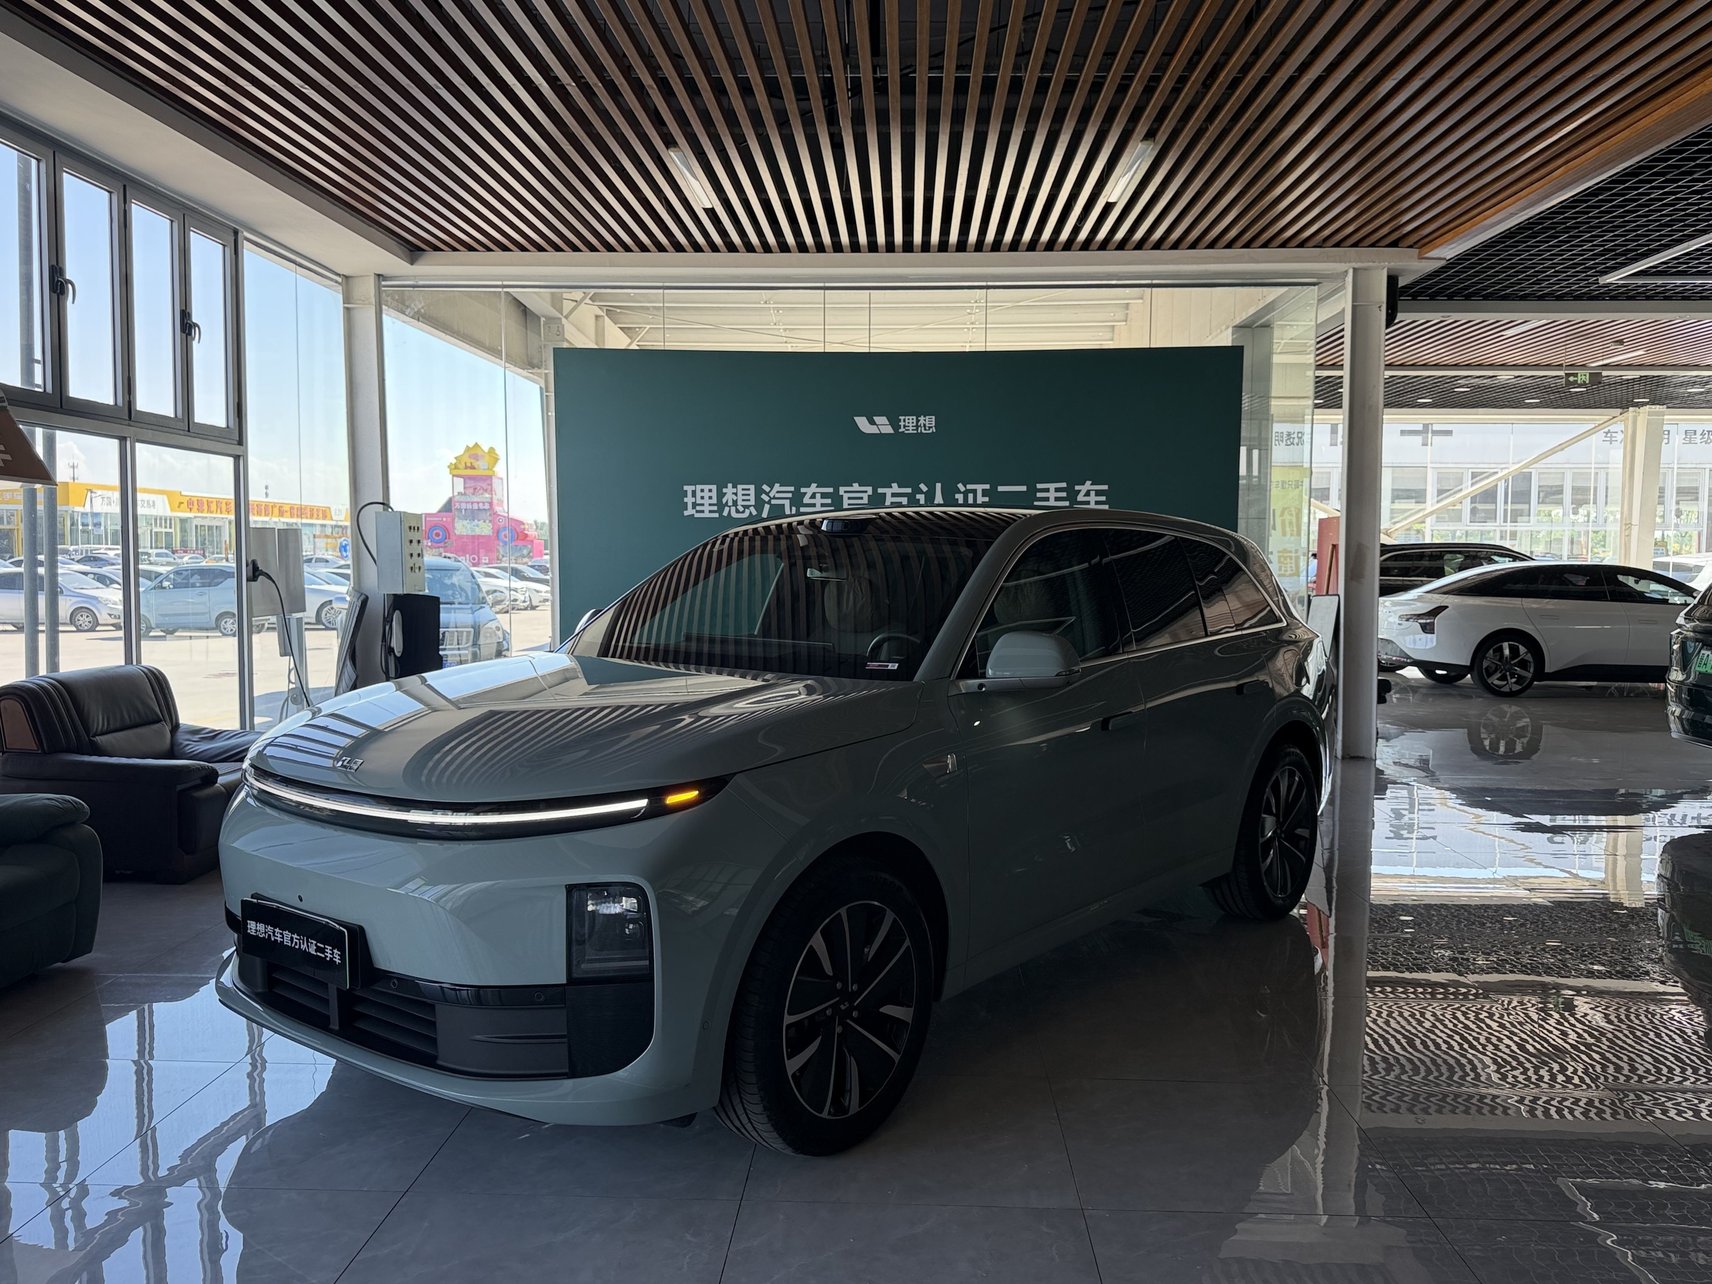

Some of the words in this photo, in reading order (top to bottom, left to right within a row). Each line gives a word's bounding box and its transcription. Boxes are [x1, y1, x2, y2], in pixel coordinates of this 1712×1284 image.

[898, 415, 936, 434] 理想
[247, 920, 342, 965] 理想汽车官方认证二手车
